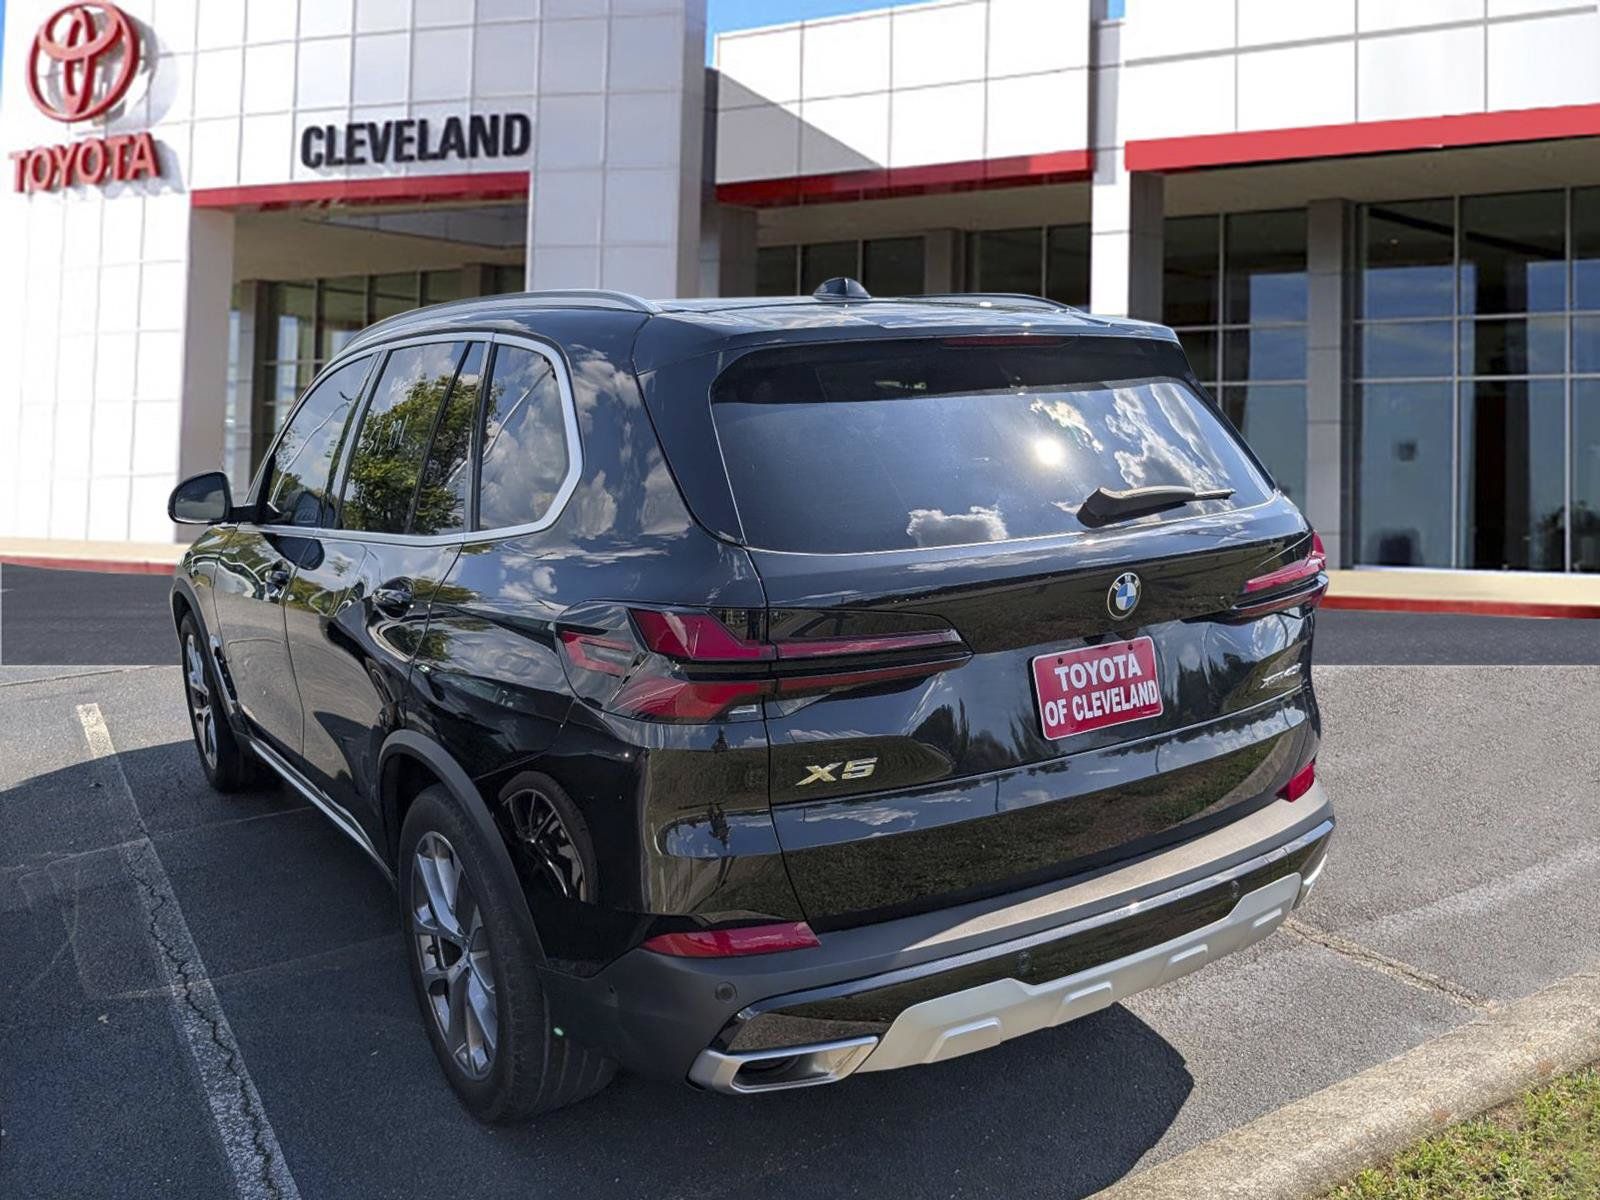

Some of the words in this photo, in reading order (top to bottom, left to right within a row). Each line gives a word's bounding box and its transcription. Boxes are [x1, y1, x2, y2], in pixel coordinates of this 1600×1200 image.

[9, 132, 161, 193] TOYOTA
[301, 113, 531, 169] CLEVELAND
[1054, 653, 1143, 692] TOYOTA
[1045, 700, 1066, 727] OF
[1072, 680, 1158, 721] CLEVELAND
[795, 757, 878, 786] X5
